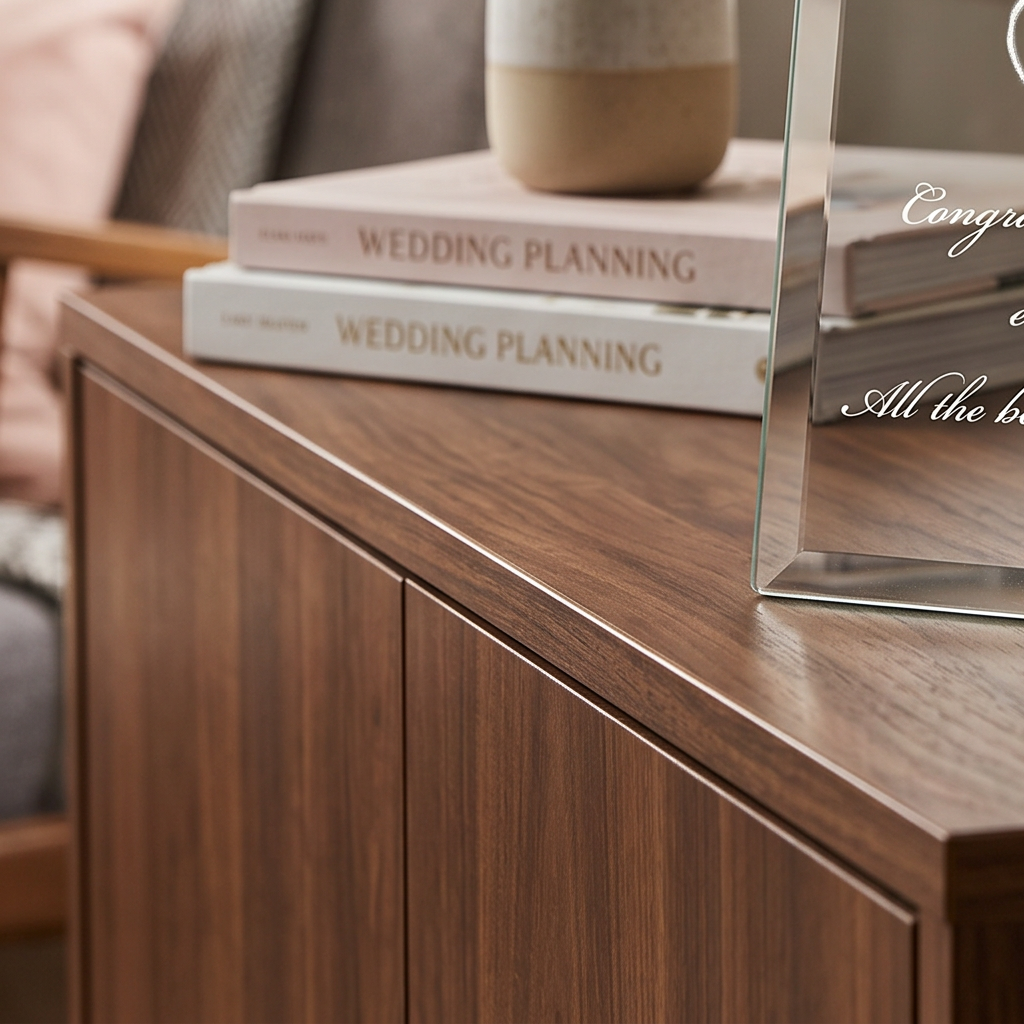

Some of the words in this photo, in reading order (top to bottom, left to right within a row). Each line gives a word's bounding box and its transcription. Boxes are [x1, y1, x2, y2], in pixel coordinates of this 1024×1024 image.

[357, 226, 513, 270] WEDDING
[524, 237, 696, 284] PLANNING
[335, 312, 487, 361] WEDDING
[497, 329, 662, 377] PLANNING
[841, 372, 966, 419] All
[930, 375, 988, 423] the
